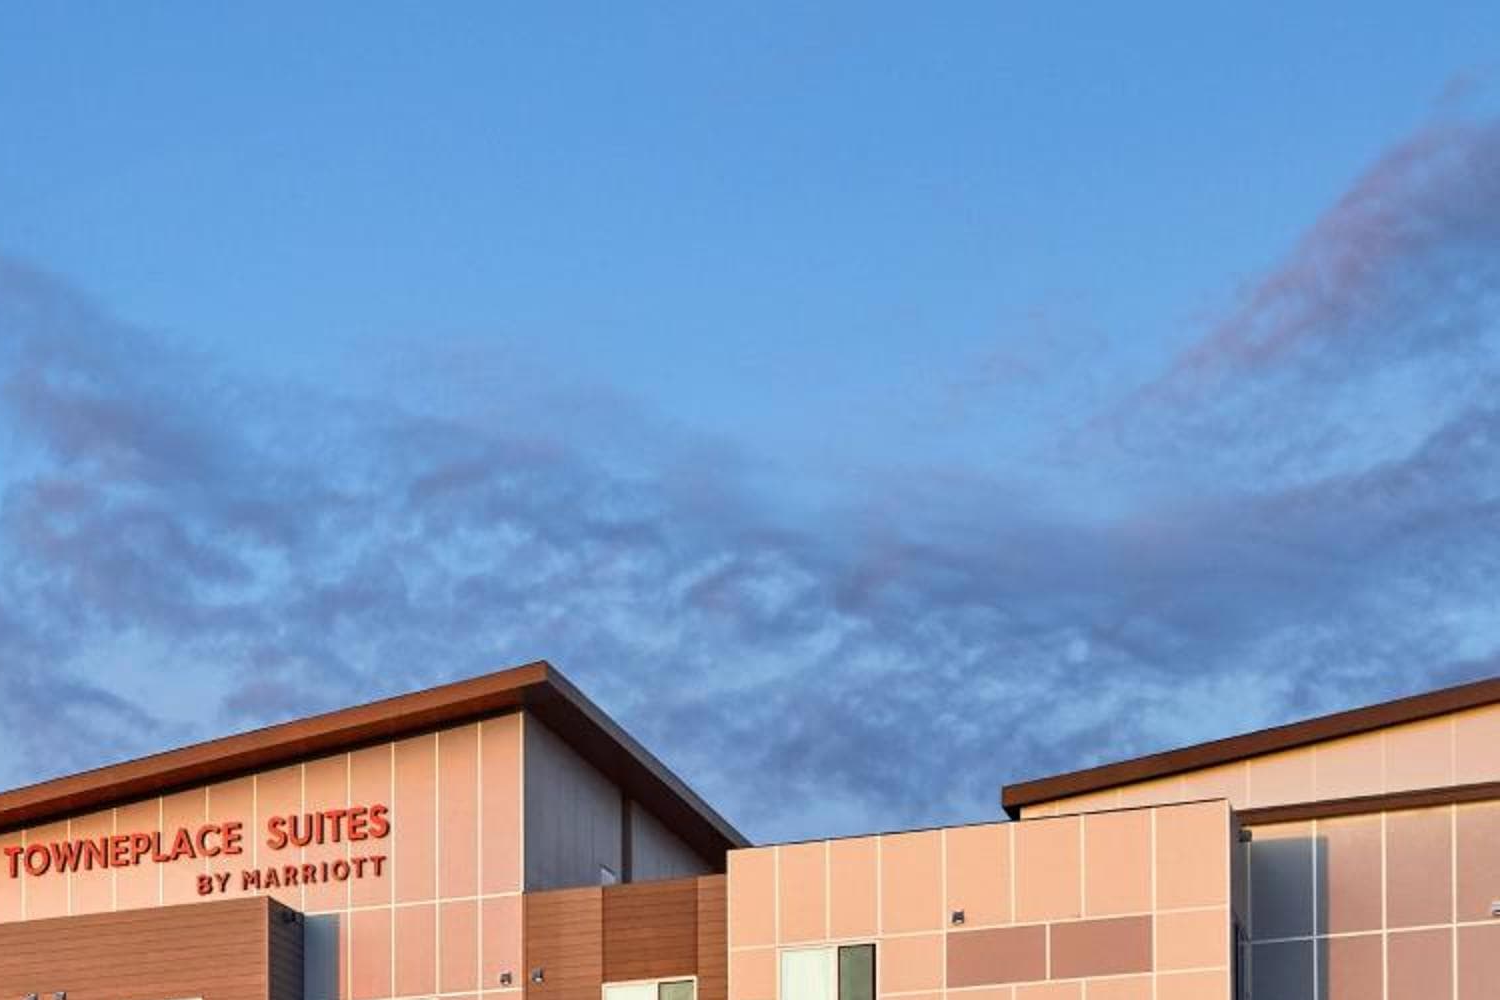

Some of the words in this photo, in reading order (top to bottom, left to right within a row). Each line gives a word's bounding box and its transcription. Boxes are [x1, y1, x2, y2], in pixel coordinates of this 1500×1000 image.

[3, 822, 243, 878] TOWNEPLACE
[266, 804, 391, 850] SUITES
[197, 868, 231, 895] BY
[242, 856, 387, 890] MARRIOTT
